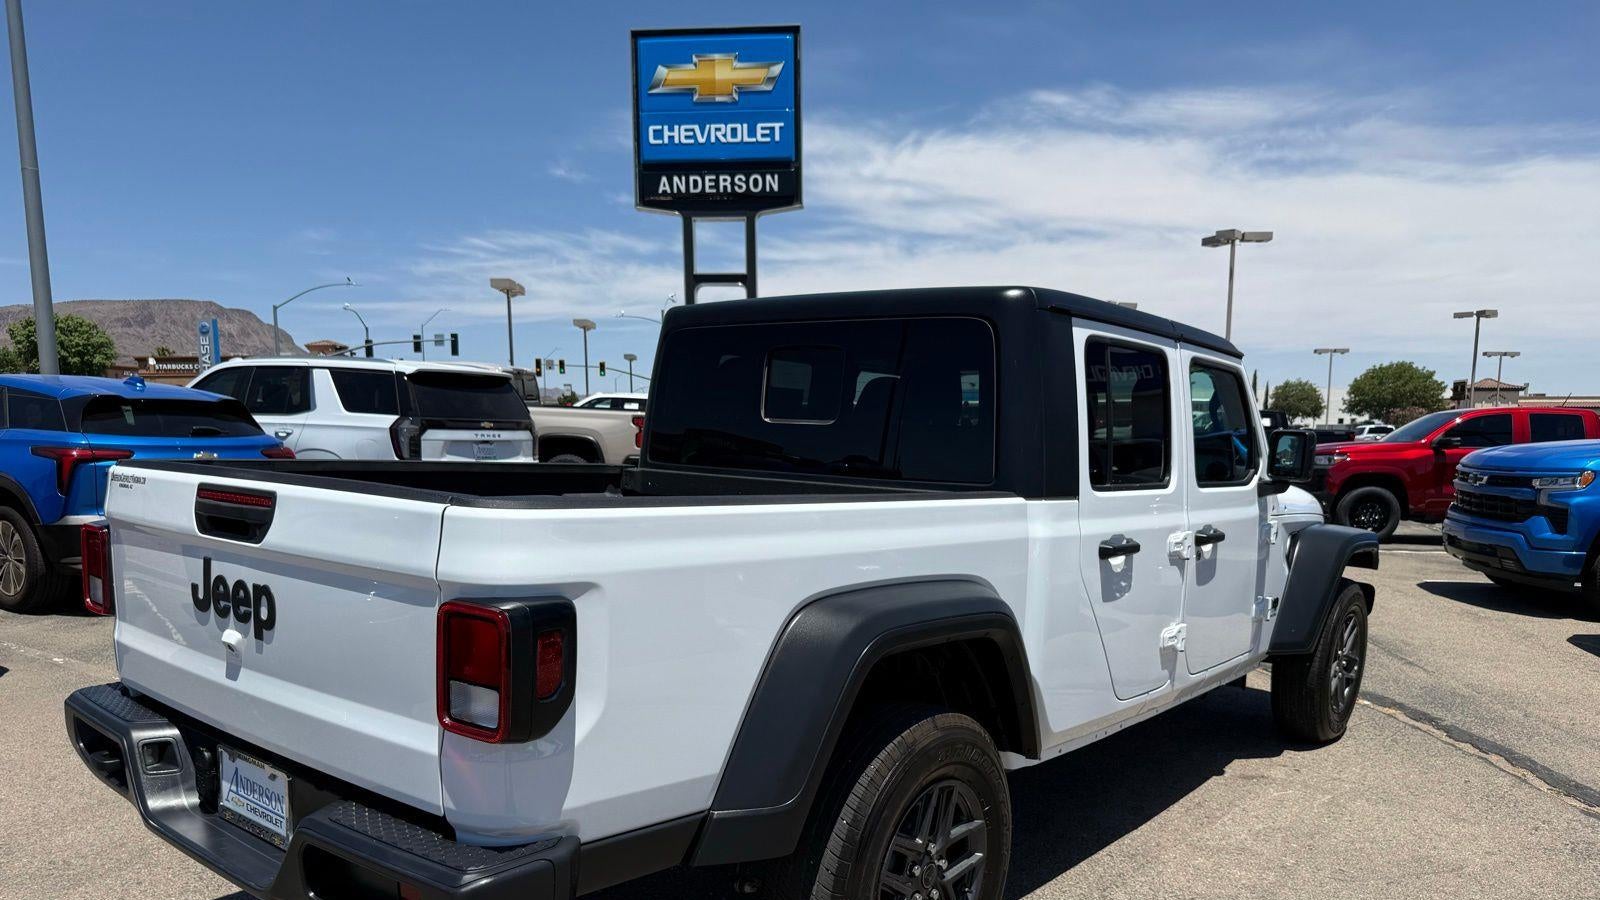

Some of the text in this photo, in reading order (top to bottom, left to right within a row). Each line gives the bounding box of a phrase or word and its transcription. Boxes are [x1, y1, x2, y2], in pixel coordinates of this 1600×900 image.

[648, 122, 784, 145] CHEVROLET
[657, 173, 779, 194] ANDERSON
[200, 336, 212, 371] HASE
[191, 556, 276, 641] Jeep
[225, 766, 285, 814] ANDERSON
[246, 803, 283, 829] CHEVROLET
